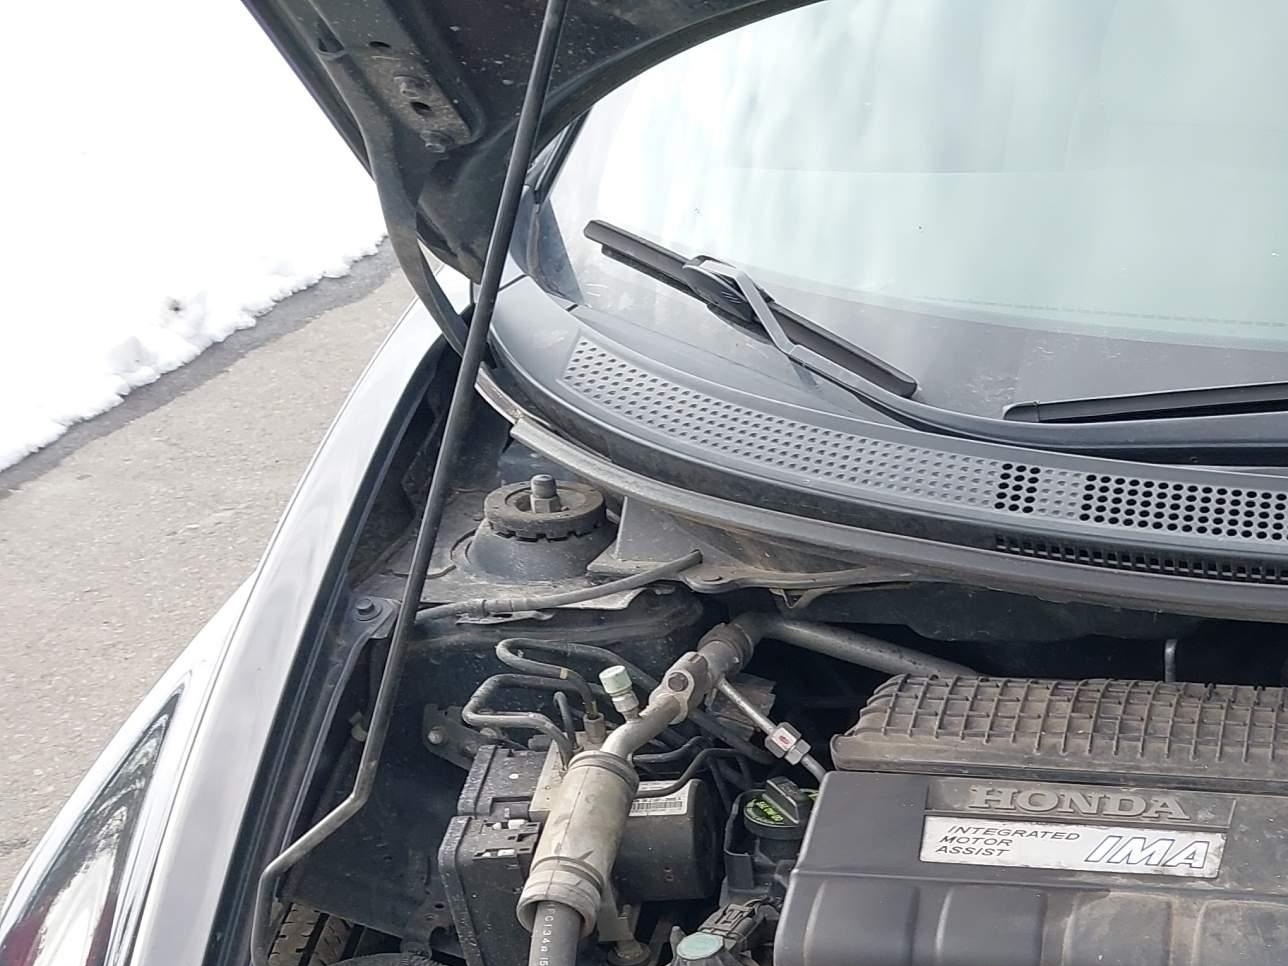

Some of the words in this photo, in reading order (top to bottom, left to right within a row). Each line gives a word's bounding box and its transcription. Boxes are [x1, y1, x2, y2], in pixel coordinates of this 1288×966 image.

[967, 784, 1190, 821] HONDA
[946, 824, 1081, 841] INTEGRATED
[940, 835, 1013, 848] MOTOR
[933, 845, 1010, 857] ASSIST
[1084, 834, 1210, 869] IMA
